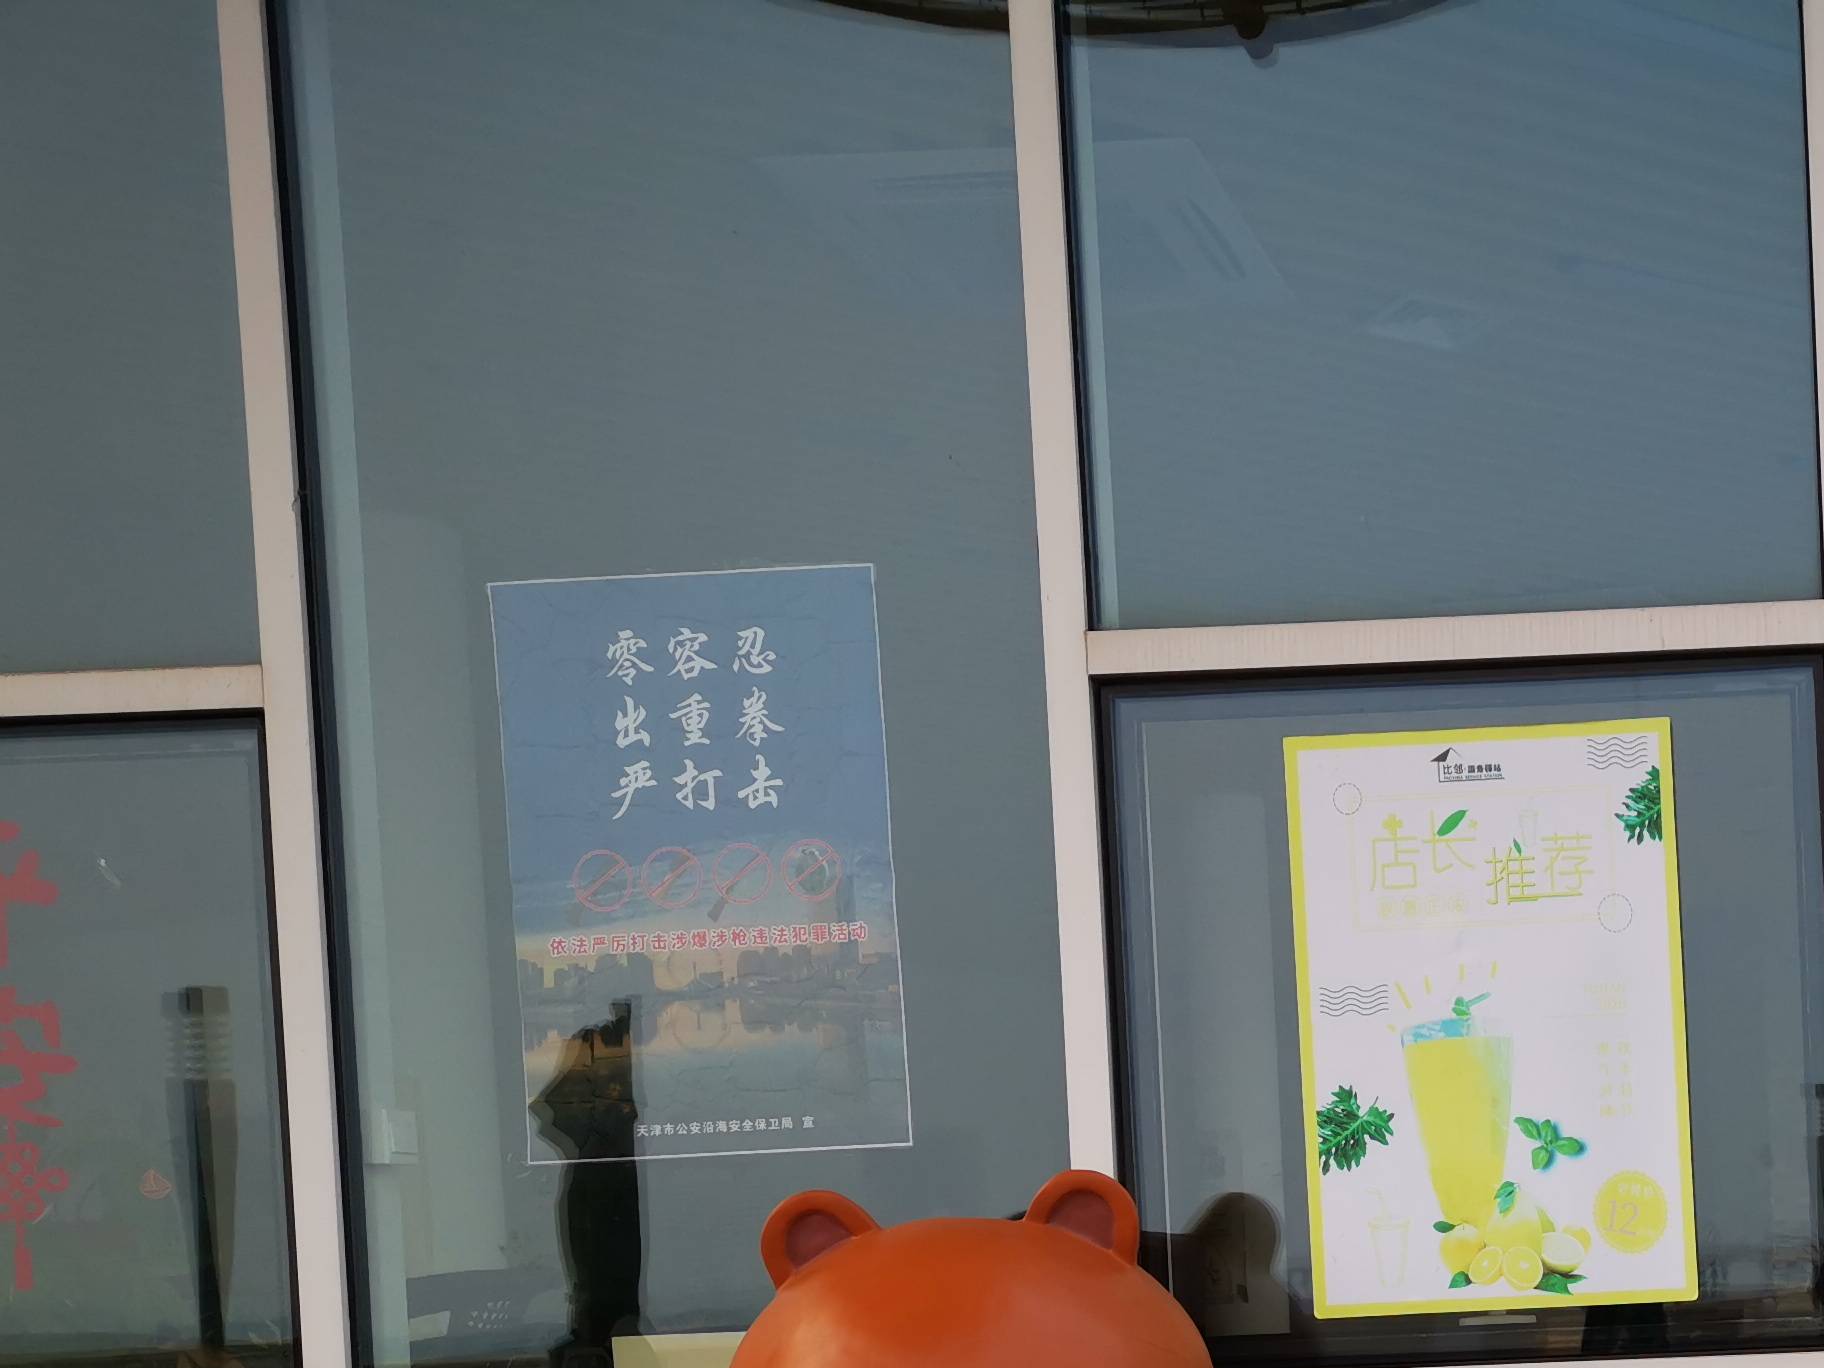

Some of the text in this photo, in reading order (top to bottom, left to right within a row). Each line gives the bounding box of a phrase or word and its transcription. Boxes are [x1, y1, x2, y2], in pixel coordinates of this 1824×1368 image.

[605, 626, 777, 686] 零容忍
[614, 686, 786, 749] 出重拳
[610, 754, 784, 821] 严打击
[1369, 810, 1596, 905] 店长推荐
[549, 922, 868, 956] 依法严厉打击涉爆涉枪违法犯罪活动
